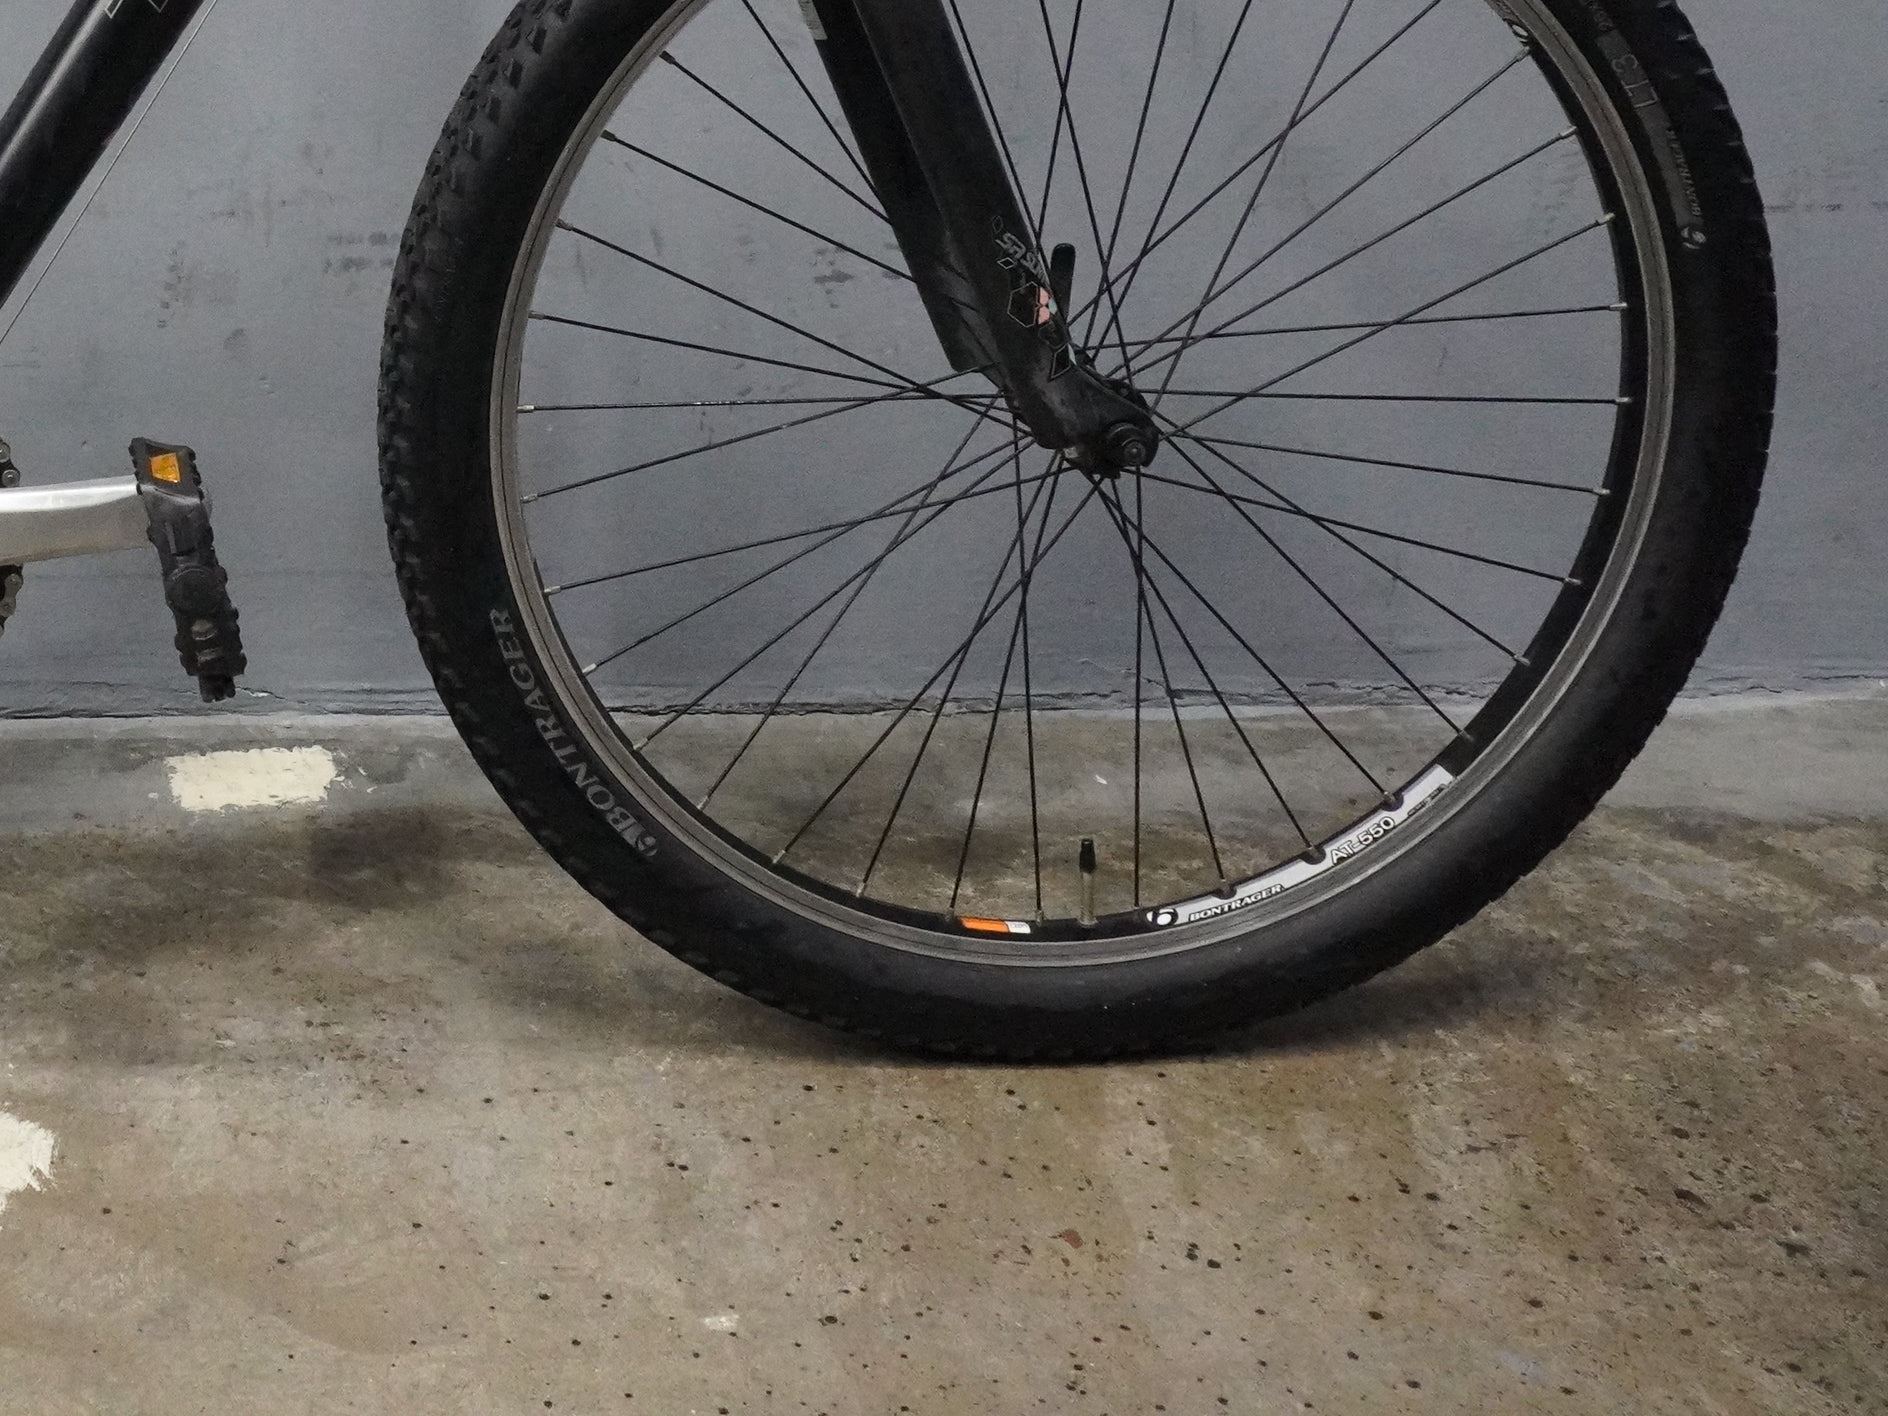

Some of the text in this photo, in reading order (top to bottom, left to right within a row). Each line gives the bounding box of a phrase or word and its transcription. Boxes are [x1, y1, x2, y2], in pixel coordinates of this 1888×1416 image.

[489, 607, 636, 833] BONTRAGER
[1330, 815, 1396, 865] AT-550
[1187, 883, 1285, 923] BONTRAGER
